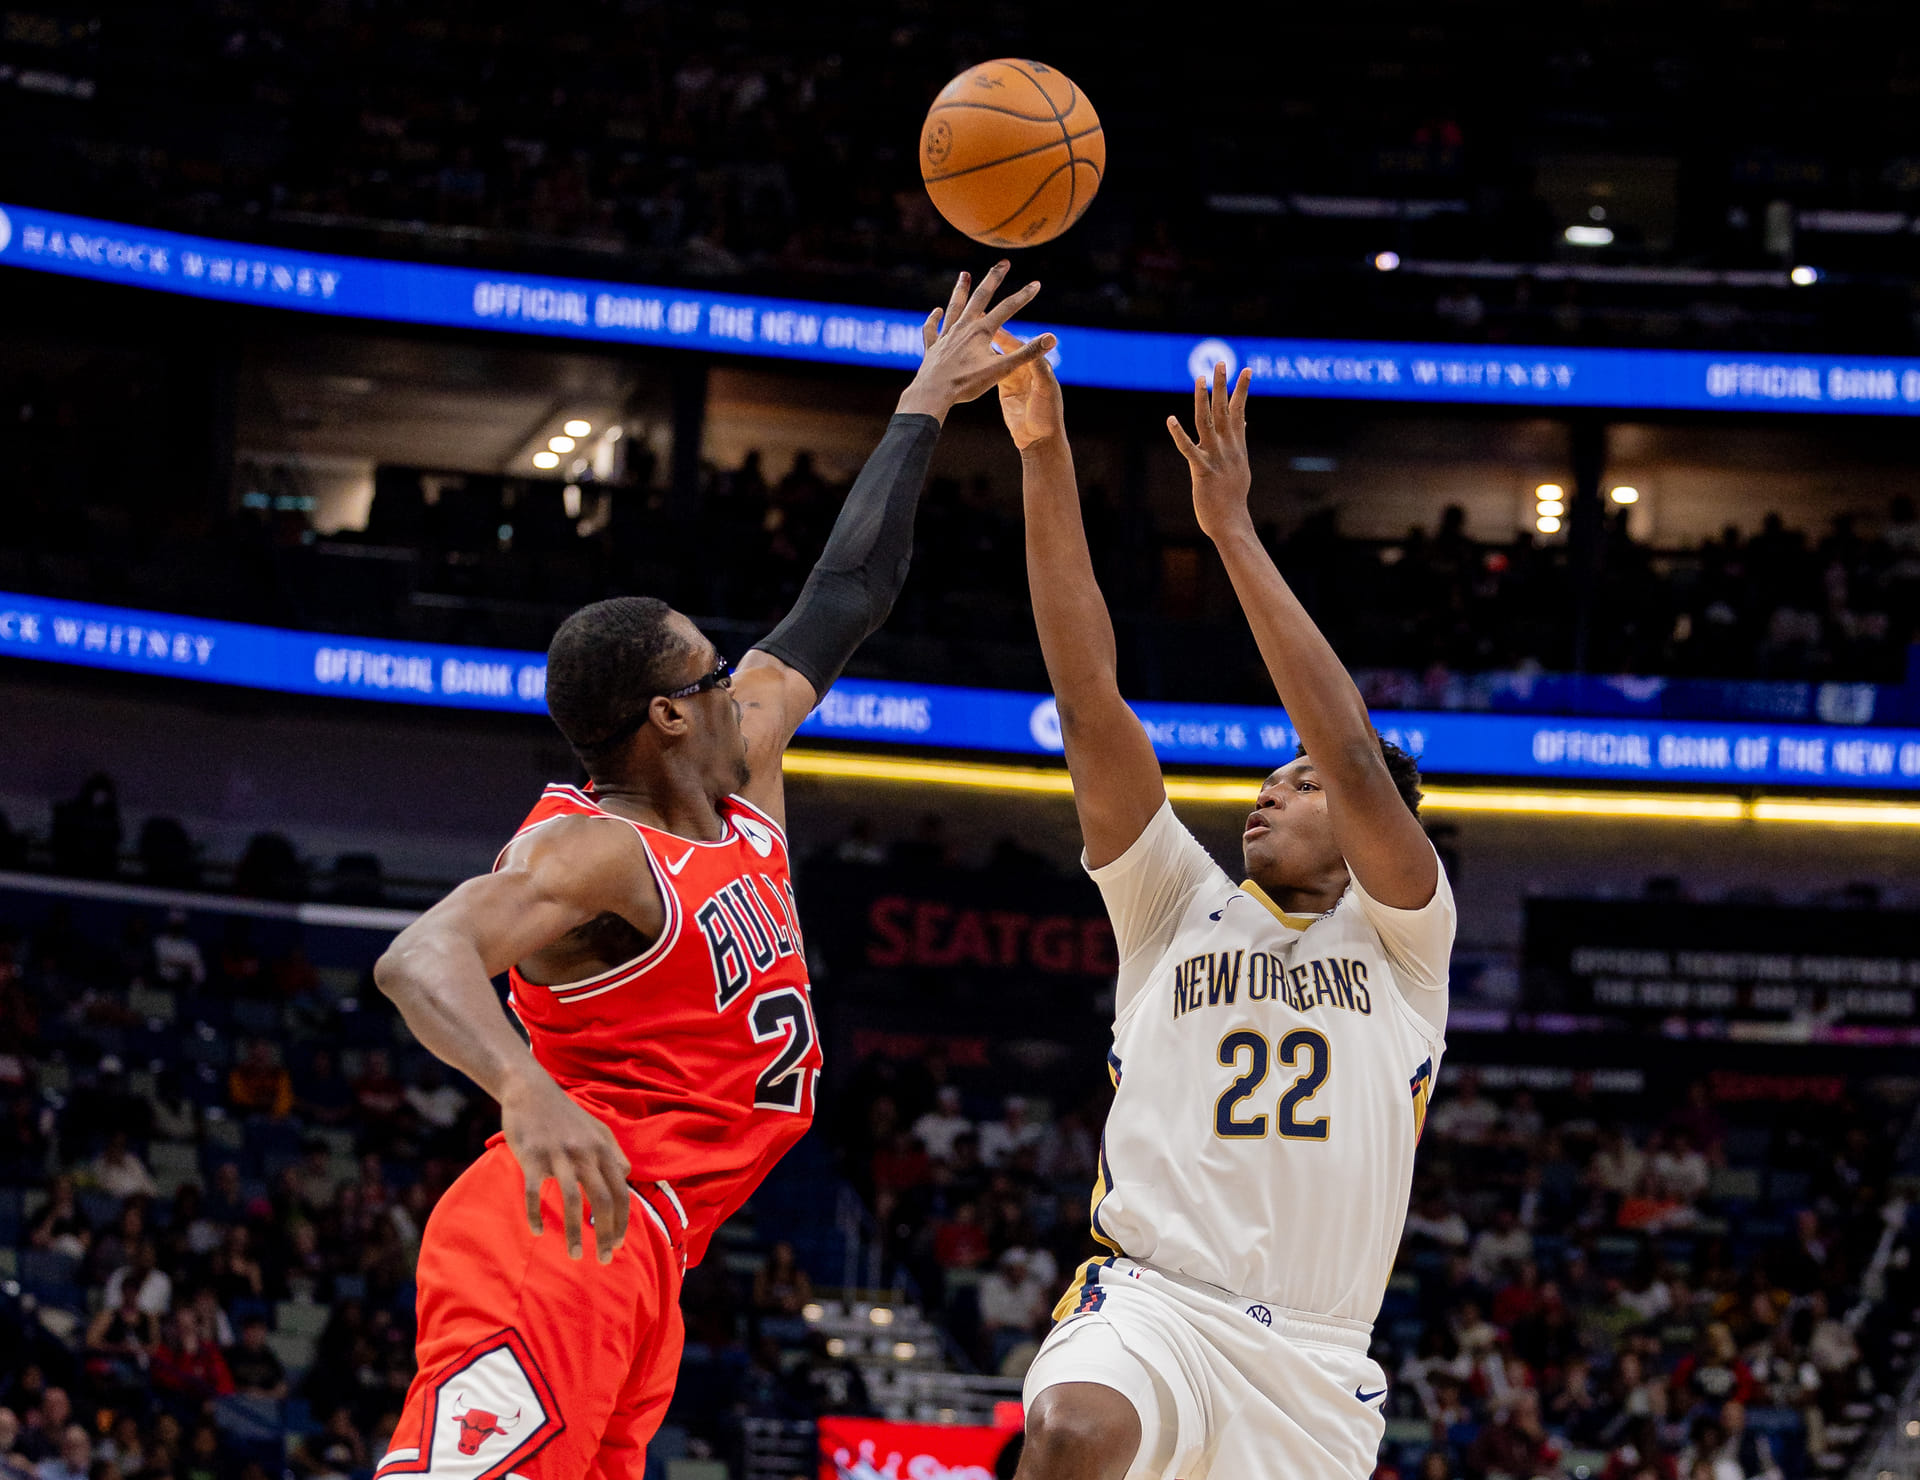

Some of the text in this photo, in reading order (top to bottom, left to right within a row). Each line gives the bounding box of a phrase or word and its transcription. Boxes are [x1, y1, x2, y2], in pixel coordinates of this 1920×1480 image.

[22, 225, 338, 298] HANCOCK WHITNEY
[473, 281, 925, 357] OFFICIAL BANK OF THE NEW ORLEAN
[1247, 355, 1573, 388] HANCOCK WHITNEY
[1705, 363, 1821, 399] OFFICIAL
[1827, 367, 1897, 400] BANK
[53, 618, 215, 665] WHITNEY
[314, 647, 433, 693] OFFICIAL
[441, 658, 512, 697] BANK
[808, 689, 931, 733] ELICANS
[1532, 730, 1651, 768] OFFICIAL
[1658, 734, 1730, 769] BANK
[1734, 736, 1770, 770] OF
[1778, 737, 1825, 775] THE
[1832, 740, 1895, 776] NEW
[694, 872, 806, 1014] BULL
[1173, 948, 1372, 1021] NEW ORLEANS
[1213, 1027, 1332, 1142] 22
